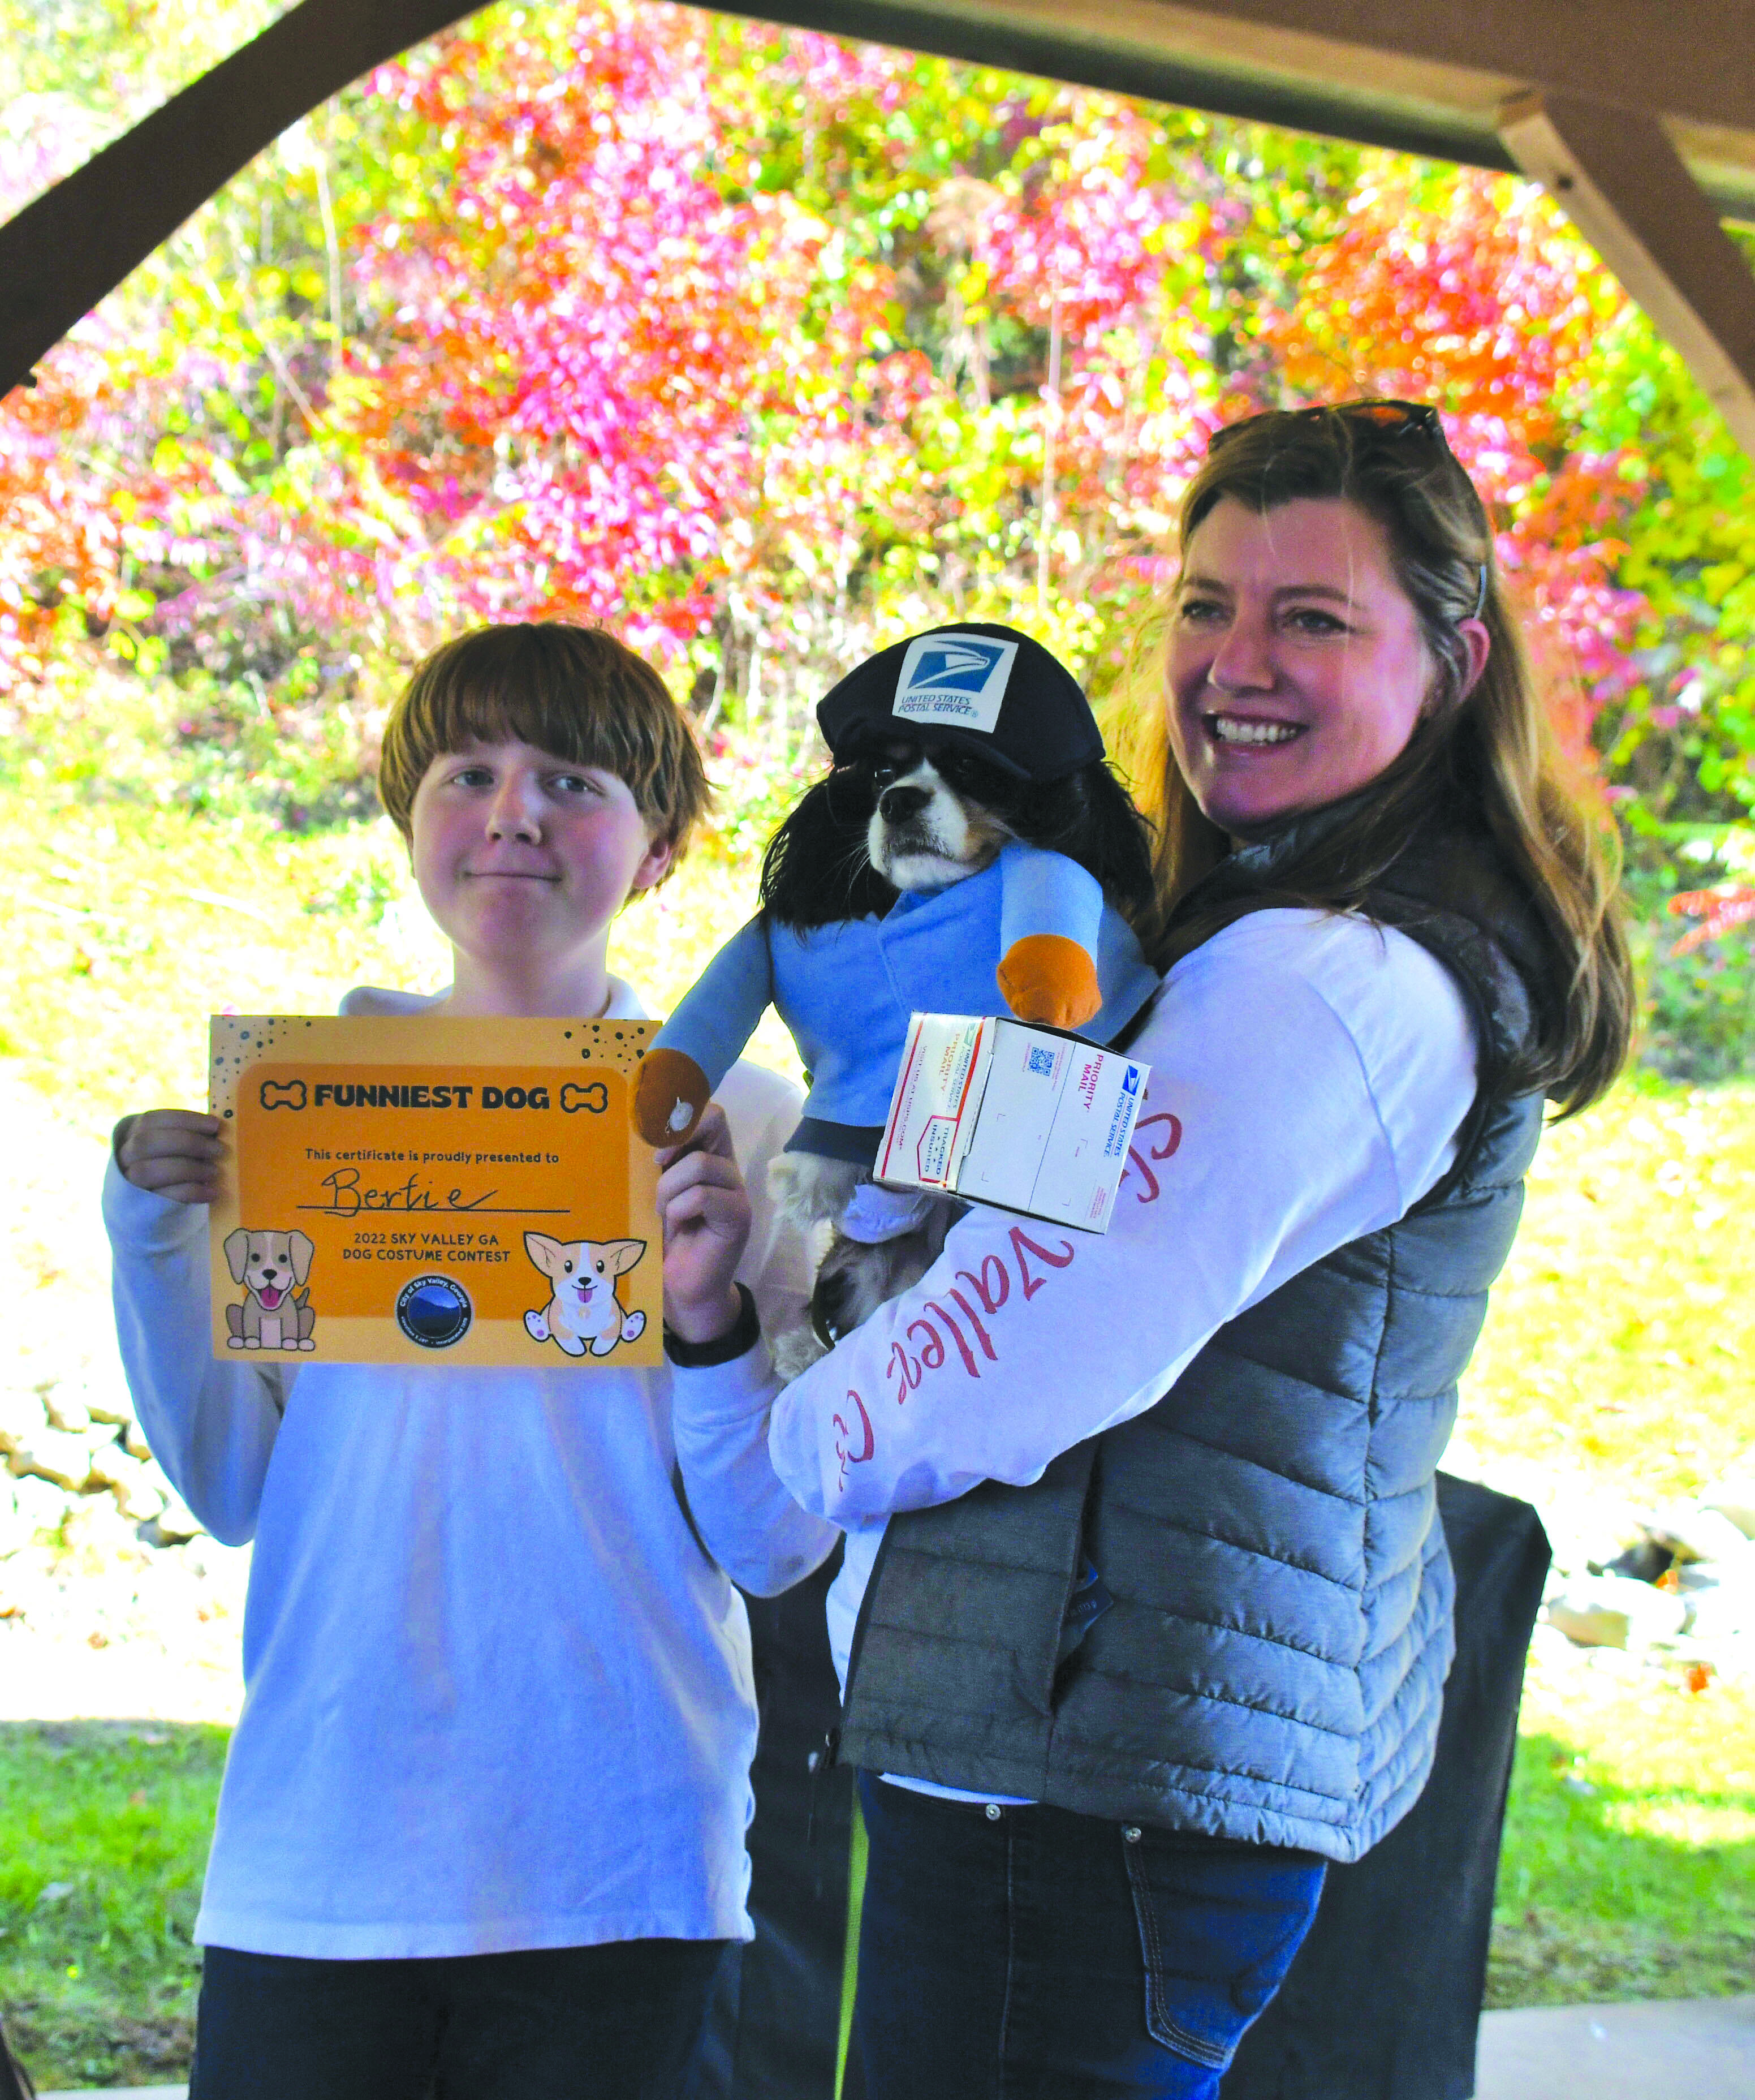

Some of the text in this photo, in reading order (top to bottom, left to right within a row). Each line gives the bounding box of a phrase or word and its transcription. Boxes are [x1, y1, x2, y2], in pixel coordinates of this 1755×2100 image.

[898, 703, 929, 713] POSTAL
[902, 694, 972, 705] UNITED STATES
[939, 1046, 950, 1075] MAIL
[941, 1033, 960, 1092] PRIORITY
[955, 1047, 965, 1075] POSTAL
[953, 1045, 972, 1109] UNITED STATES
[1077, 1064, 1092, 1092] MAIL
[1083, 1054, 1104, 1110] PRIORITY
[314, 1085, 550, 1109] FUNNIEST DOG
[1113, 1092, 1126, 1124] POSTAL
[1114, 1097, 1135, 1157] UNITED STATES
[305, 1148, 559, 1164] This certificate is proudly presented to
[924, 1125, 937, 1172] INSURED
[936, 1127, 950, 1174] TRACKED
[321, 1168, 498, 1217] Bertie
[355, 1233, 499, 1246] 2022 SKY VALLEY GA
[343, 1249, 511, 1262] DOG COSTUME CONTEST
[400, 1293, 410, 1307] City
[414, 1280, 426, 1288] Sky
[886, 1226, 1075, 1404] Valley
